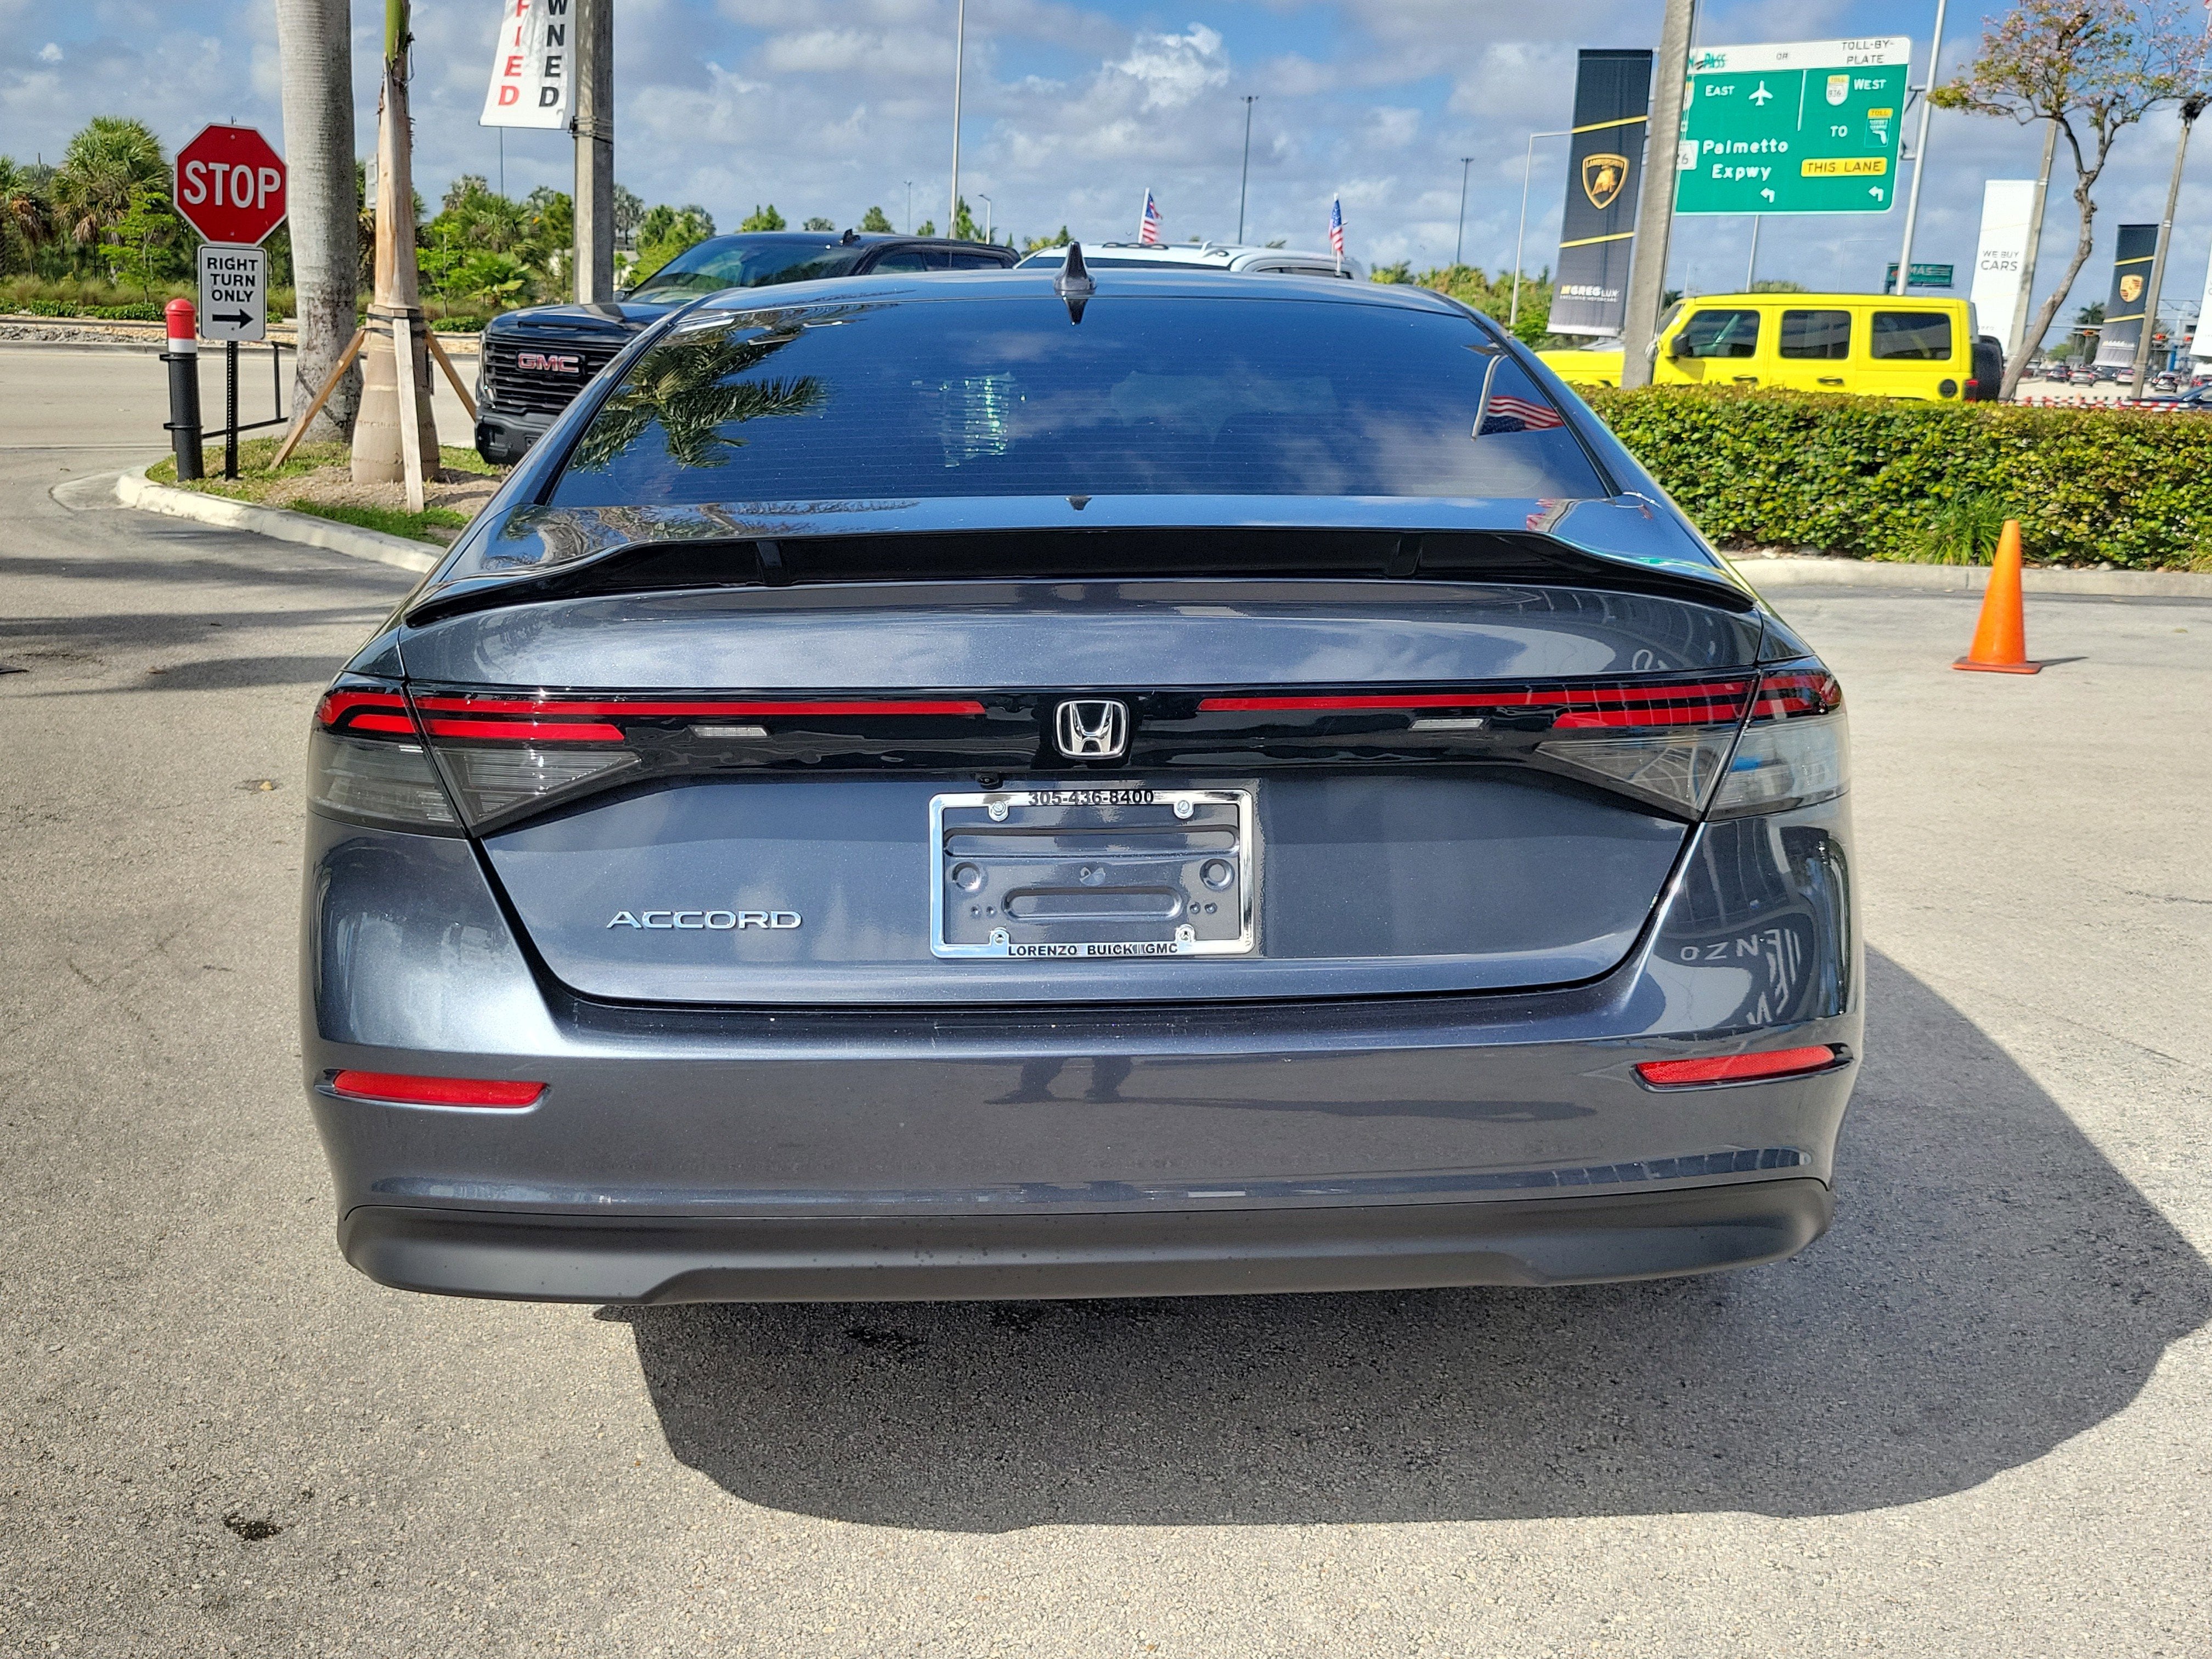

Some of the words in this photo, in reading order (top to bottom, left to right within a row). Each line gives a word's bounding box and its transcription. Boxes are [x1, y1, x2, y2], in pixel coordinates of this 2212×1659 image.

[1847, 55, 1884, 64] PLATE
[1830, 125, 1848, 137] TO
[1703, 138, 1788, 155] Palmetto
[1712, 163, 1772, 181] Expwy
[1807, 162, 1836, 173] THIS
[1844, 161, 1882, 172] LANE
[183, 160, 281, 209] STOP
[207, 257, 258, 271] RIGHT
[1980, 260, 2018, 271] CARS
[210, 273, 256, 287] TURN
[211, 289, 254, 302] ONLY
[518, 352, 579, 373] GMC
[1028, 790, 1154, 805] 305-436-8400
[606, 911, 802, 929] ACCORD
[1008, 945, 1077, 956] LORENZO
[1087, 944, 1133, 955] BUICK
[1146, 943, 1178, 954] GMC
